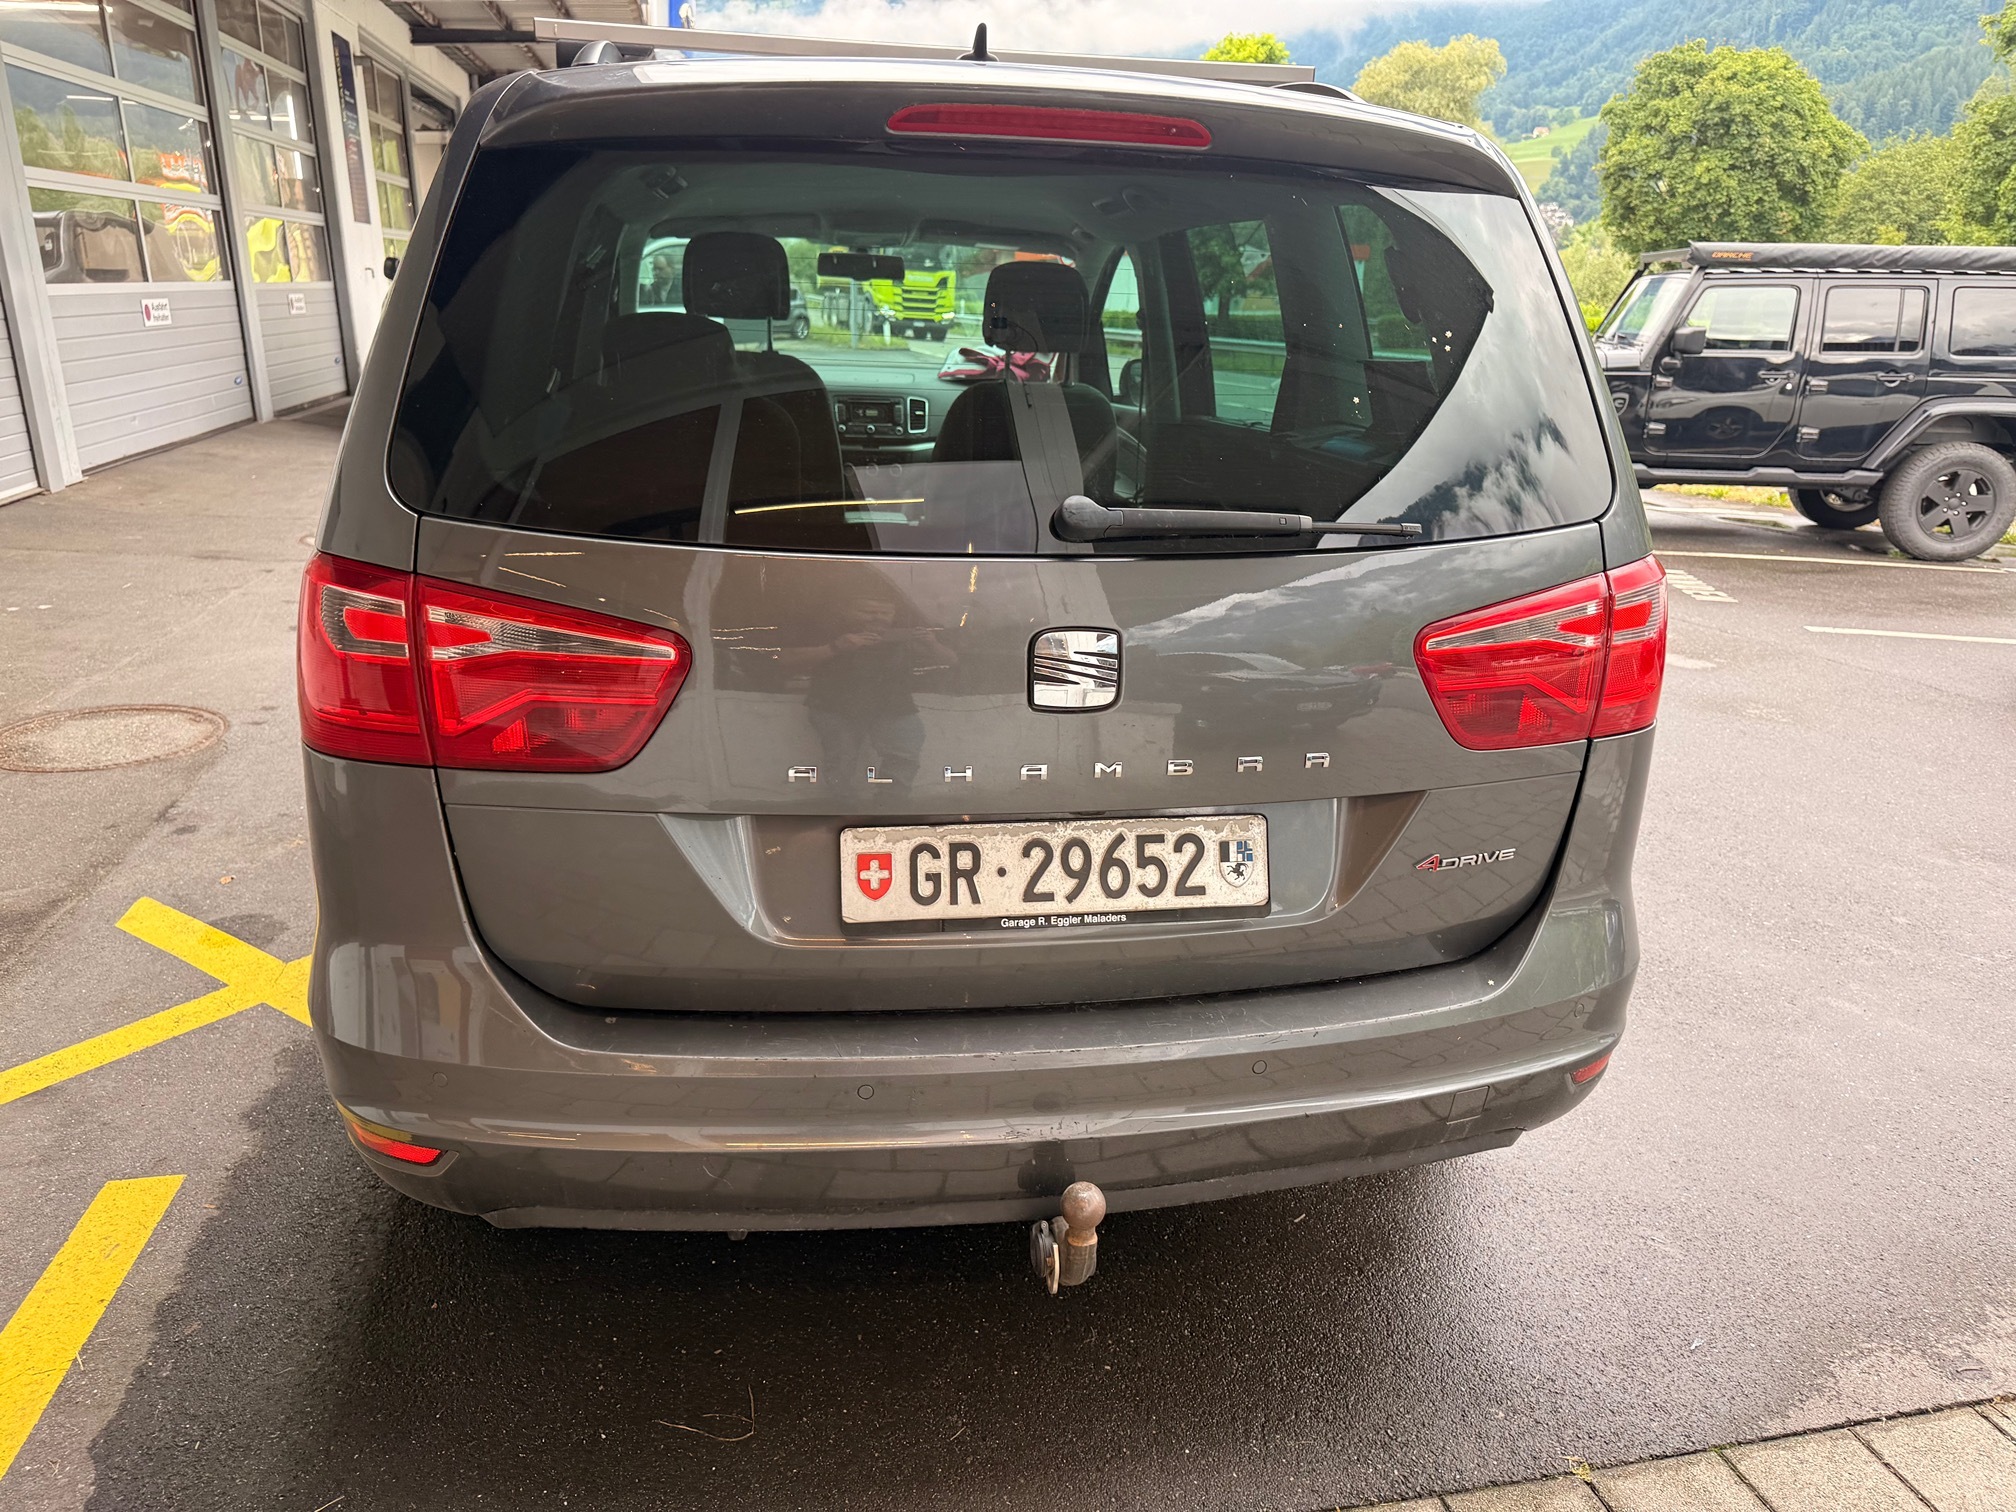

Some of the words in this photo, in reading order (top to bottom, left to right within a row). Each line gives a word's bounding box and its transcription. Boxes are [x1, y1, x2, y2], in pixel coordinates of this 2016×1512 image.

[788, 752, 1331, 783] ALHAMBRA
[909, 842, 982, 906] GR
[1022, 833, 1207, 904] 29652
[1415, 848, 1516, 872] 4DRIVE
[1000, 918, 1036, 928] Garage
[1038, 916, 1048, 925] R.
[1051, 916, 1082, 926] Eggler
[1084, 914, 1127, 923] Maladers
